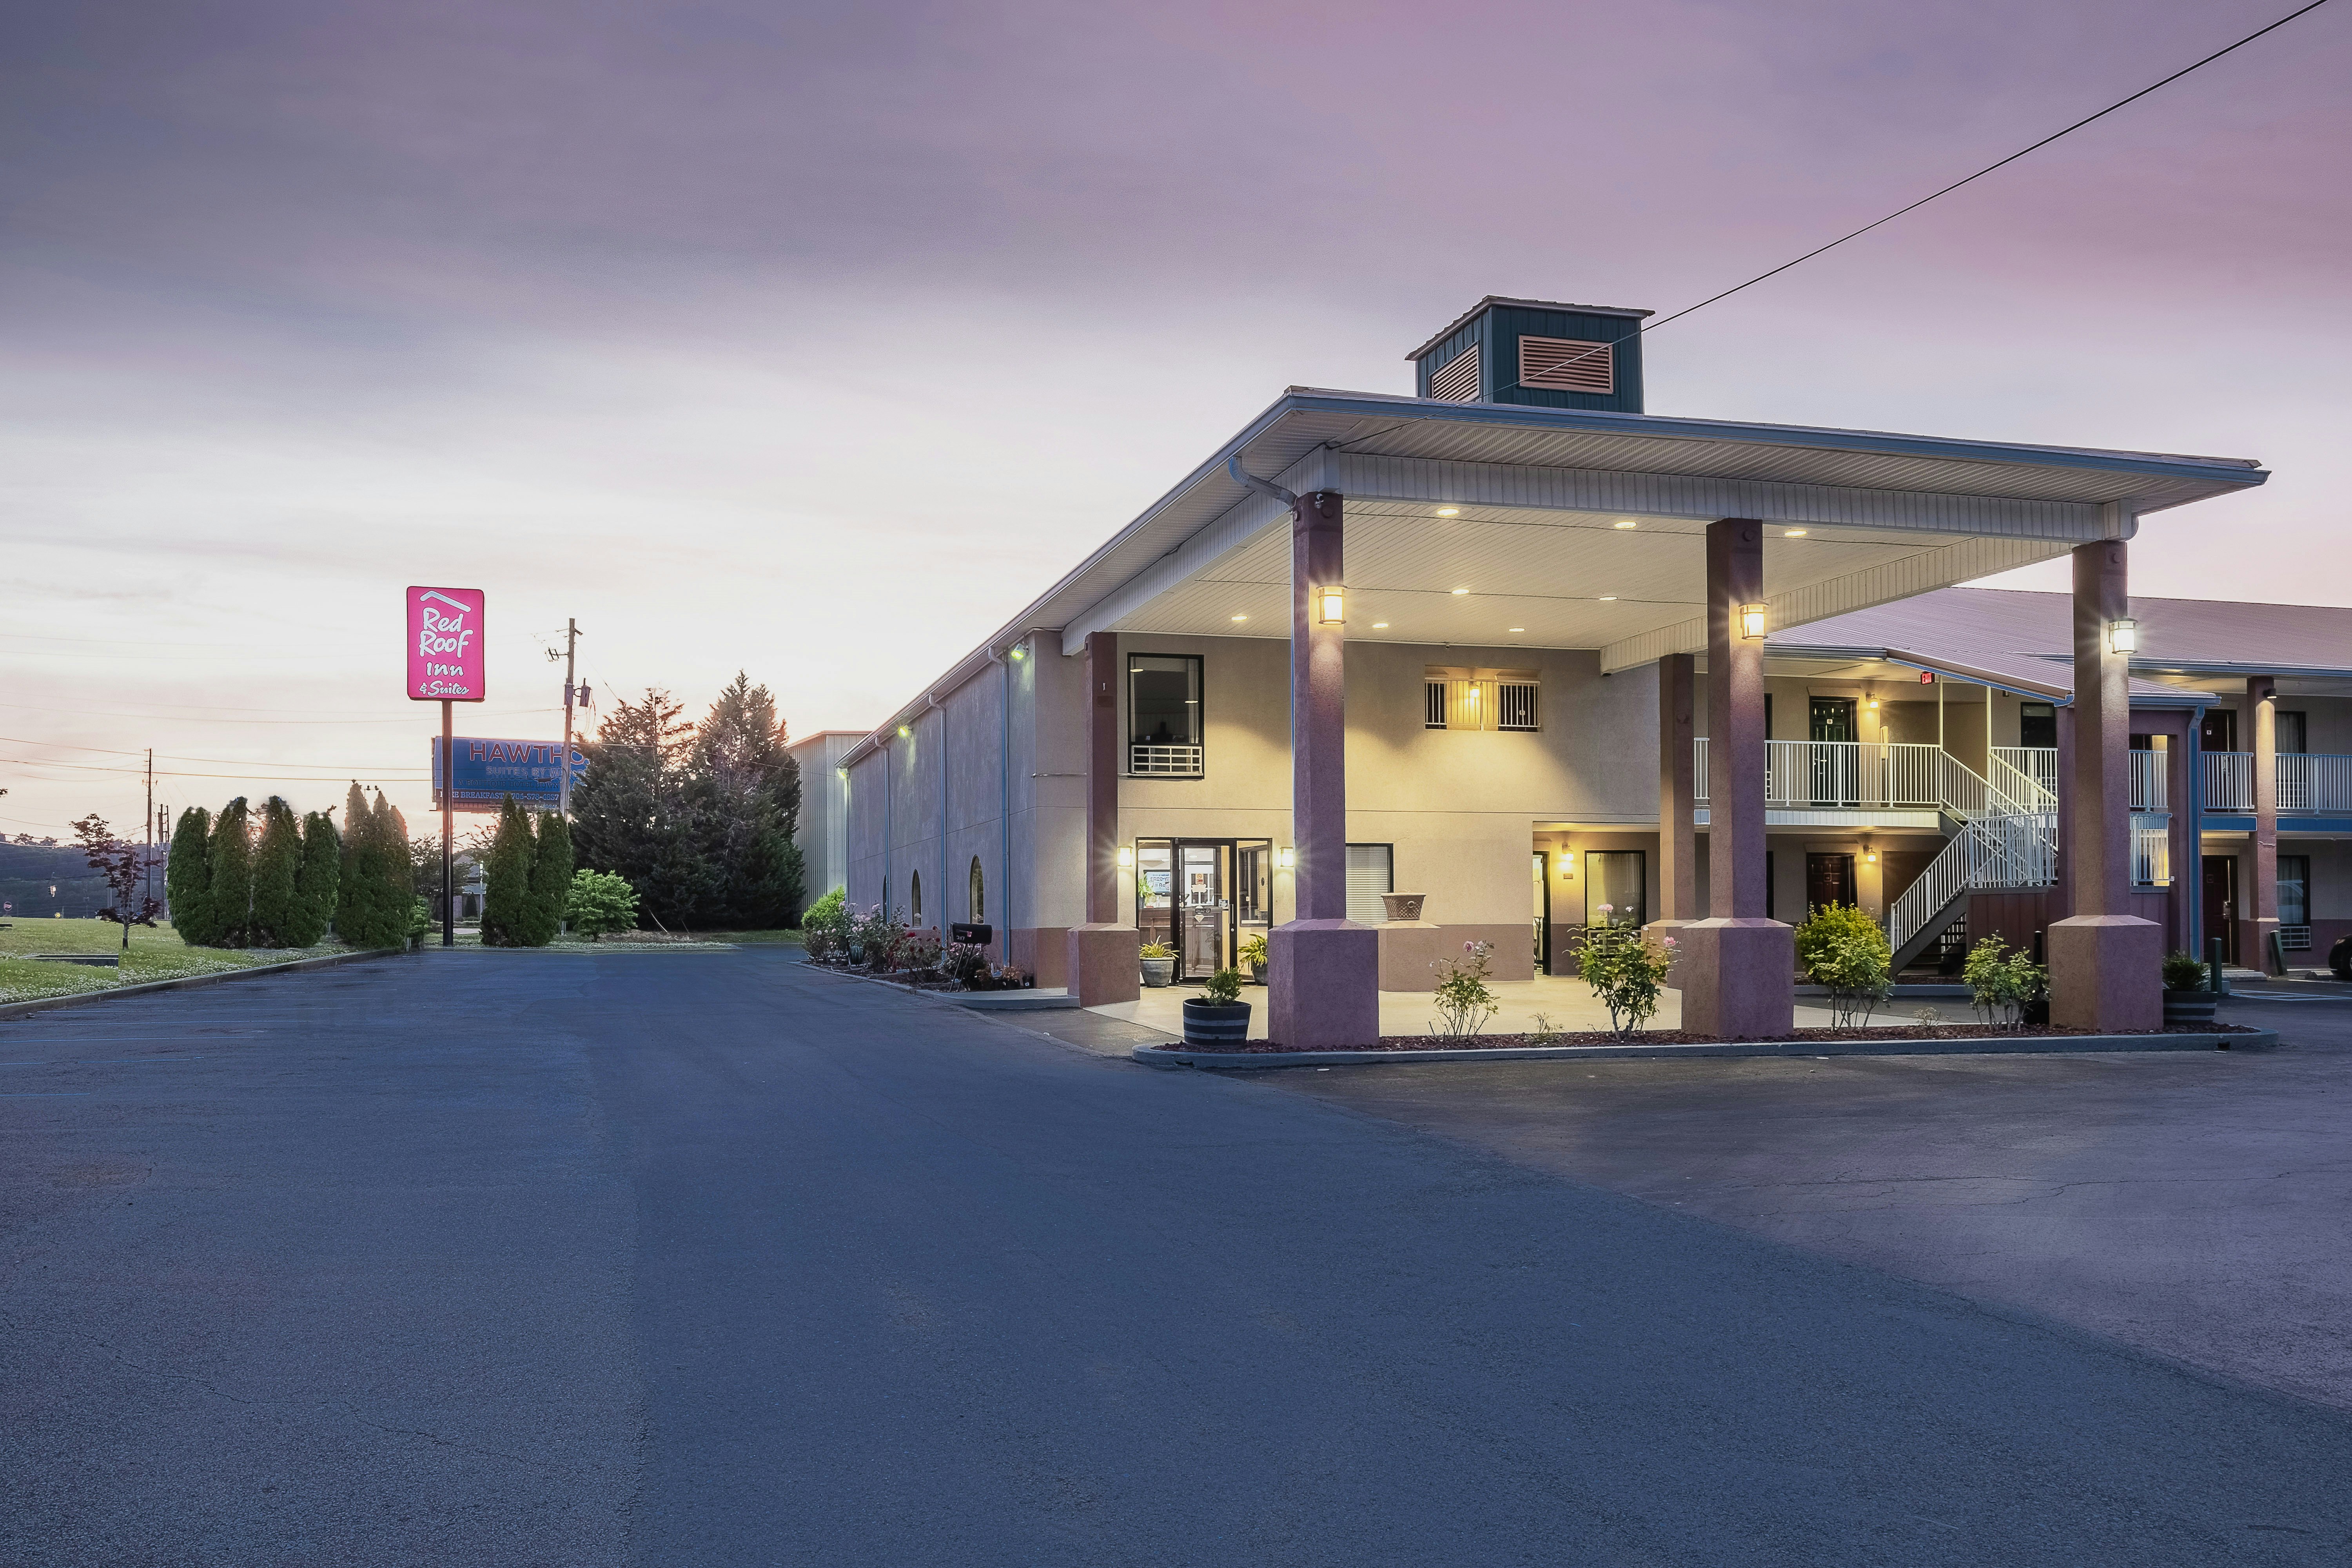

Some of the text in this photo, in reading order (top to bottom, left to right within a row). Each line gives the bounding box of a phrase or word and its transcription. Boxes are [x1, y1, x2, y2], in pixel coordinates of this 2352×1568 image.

[423, 607, 464, 632] Red
[419, 630, 474, 658] Roof
[419, 680, 470, 696] & Suites
[486, 766, 528, 776] SUITES
[532, 767, 546, 776] BY
[466, 780, 506, 788] BOUTIQUE
